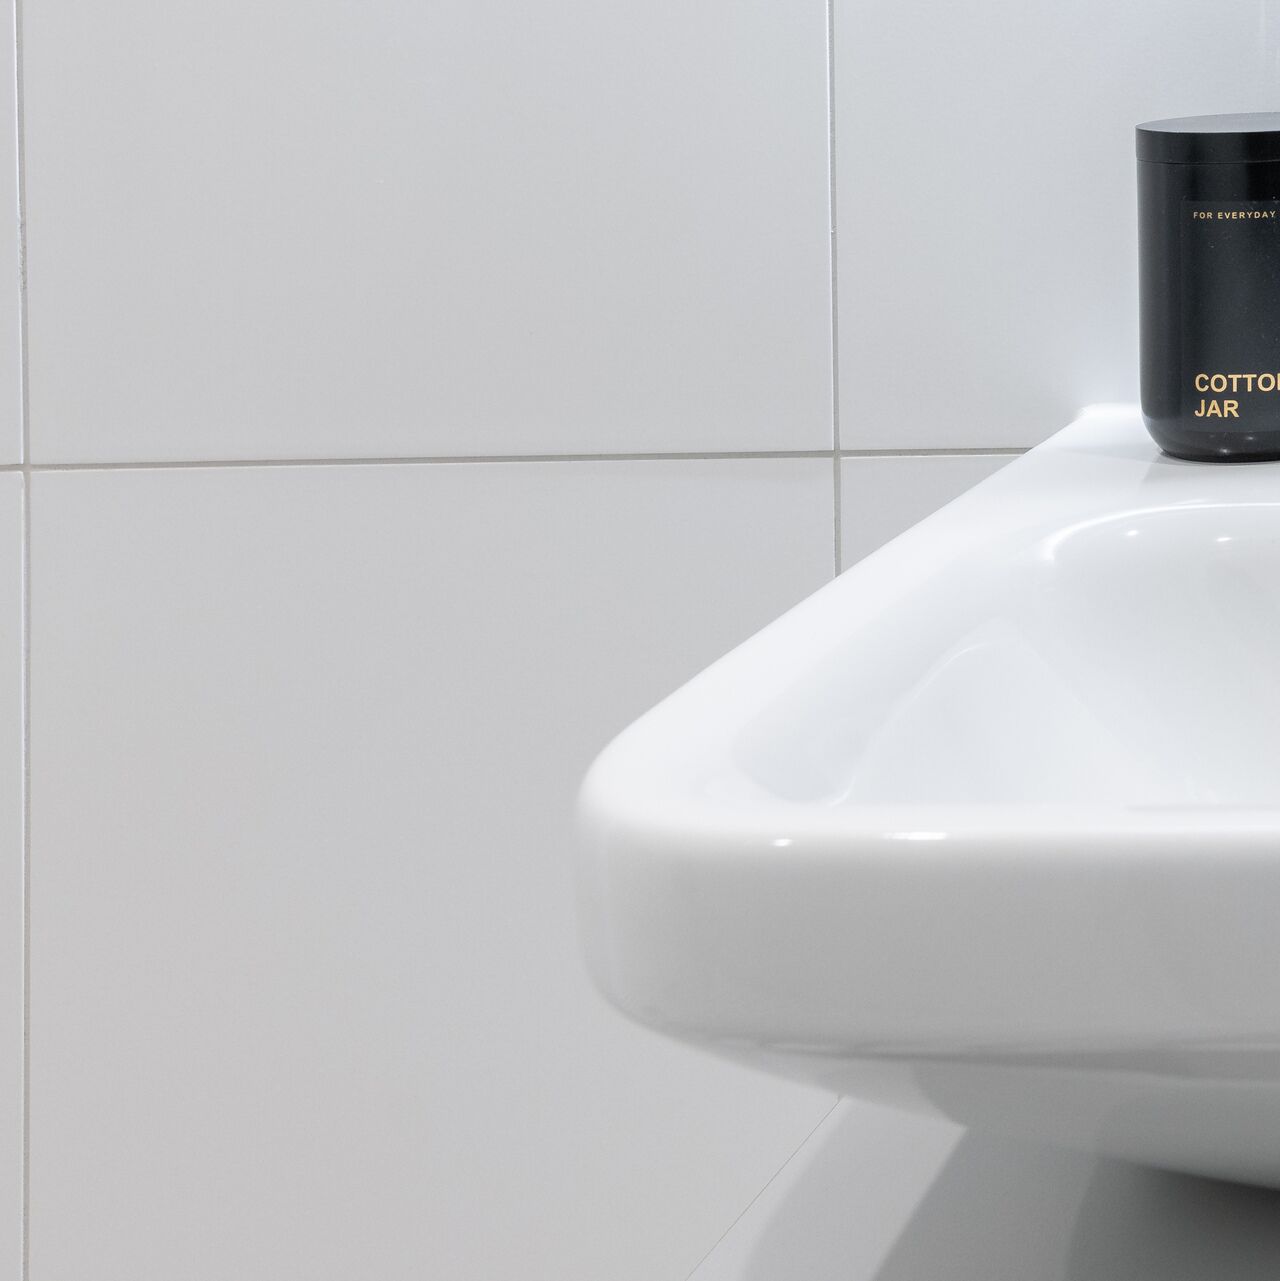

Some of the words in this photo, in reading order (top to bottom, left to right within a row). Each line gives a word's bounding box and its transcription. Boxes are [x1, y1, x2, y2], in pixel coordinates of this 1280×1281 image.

[1193, 211, 1213, 219] FOR
[1217, 210, 1276, 219] EVERYDAY
[1194, 399, 1240, 418] JAR
